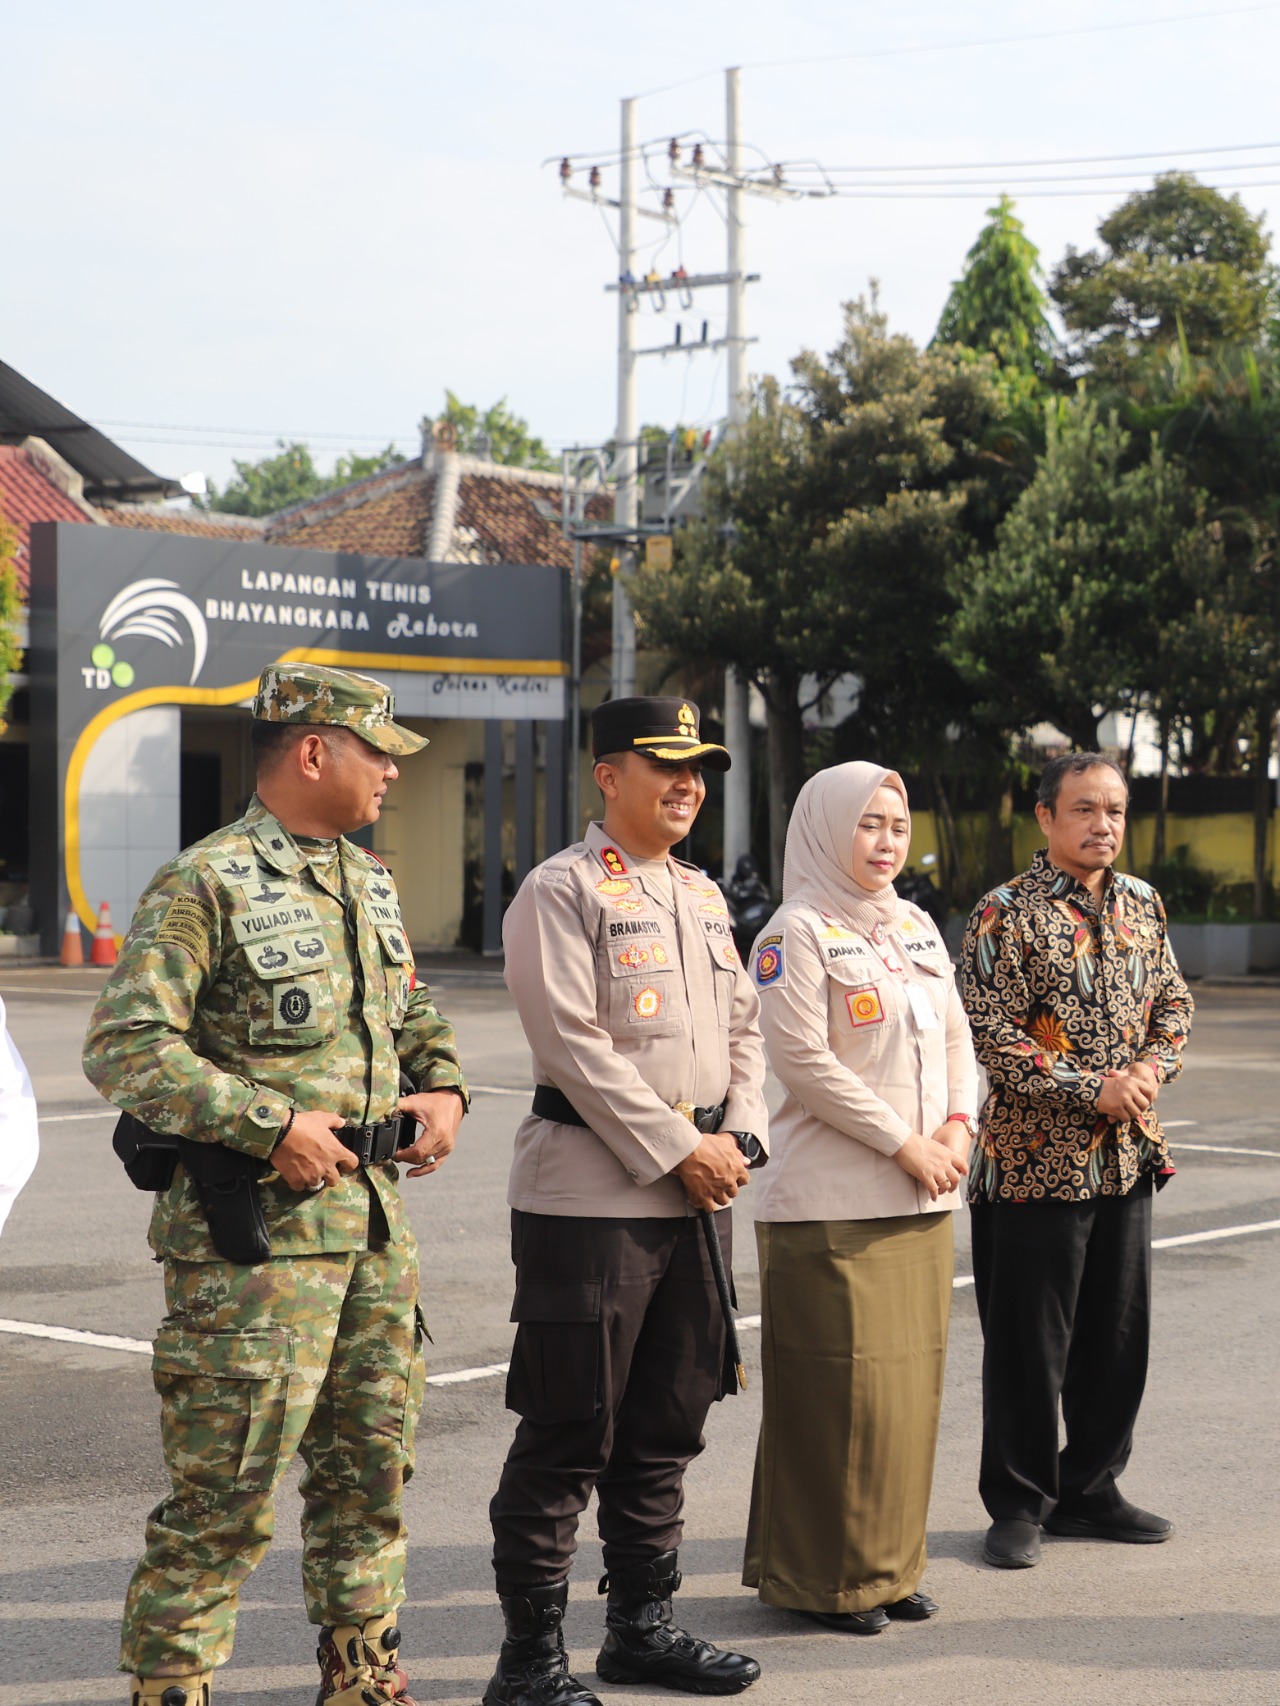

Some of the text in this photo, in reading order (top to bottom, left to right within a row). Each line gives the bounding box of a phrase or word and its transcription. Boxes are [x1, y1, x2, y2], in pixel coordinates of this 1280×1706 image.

[241, 568, 431, 604] LAPANGAN TENIS
[205, 597, 478, 639] BHAYANGKARA Reborn
[81, 666, 111, 690] TD
[177, 897, 216, 917] KOMANDO
[370, 906, 392, 919] TNI
[241, 907, 314, 934] YULIADI.PM
[609, 920, 661, 938] BRAMASTYO
[828, 946, 857, 959] DIAH
[905, 940, 937, 952] POL PP
